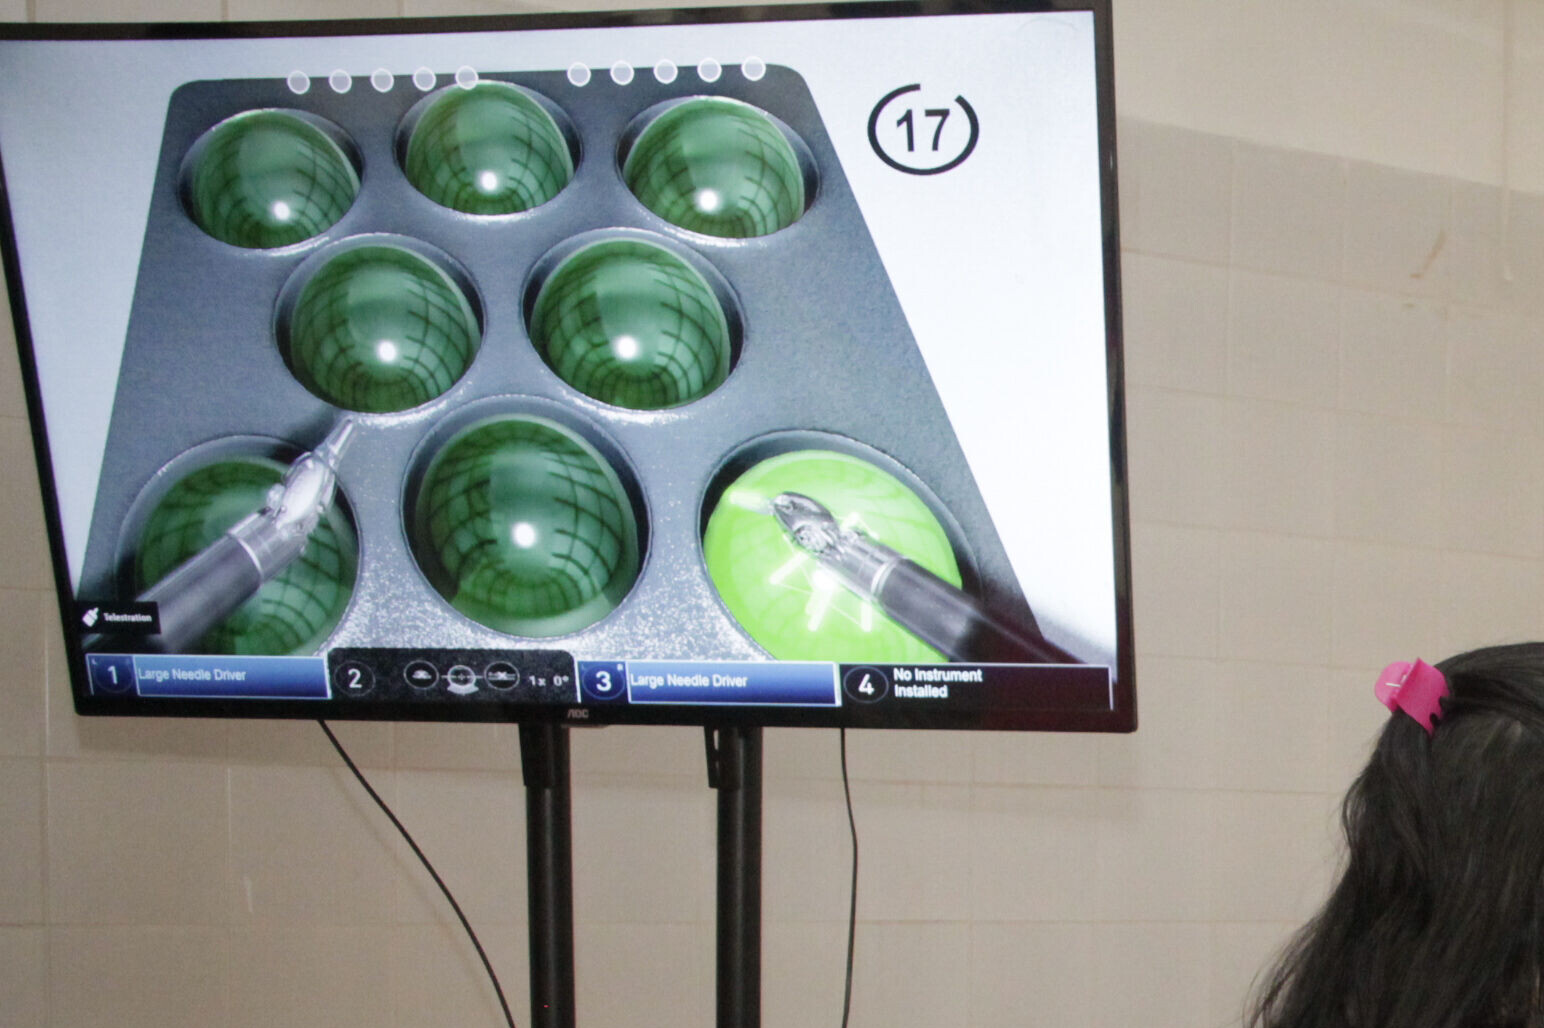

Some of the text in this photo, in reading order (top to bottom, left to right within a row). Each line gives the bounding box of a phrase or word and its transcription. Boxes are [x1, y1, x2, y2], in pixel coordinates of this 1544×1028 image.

[897, 109, 950, 152] 17
[103, 612, 152, 622] Telestration
[108, 666, 118, 685] 1
[138, 668, 246, 682] Large Needle Driver
[347, 668, 362, 688] 2
[529, 675, 546, 687] 1x
[596, 671, 612, 692] 3
[630, 673, 747, 690] Large Needle Driver
[893, 668, 983, 682] No Instrument
[858, 673, 875, 695] 4
[894, 684, 948, 698] Installed
